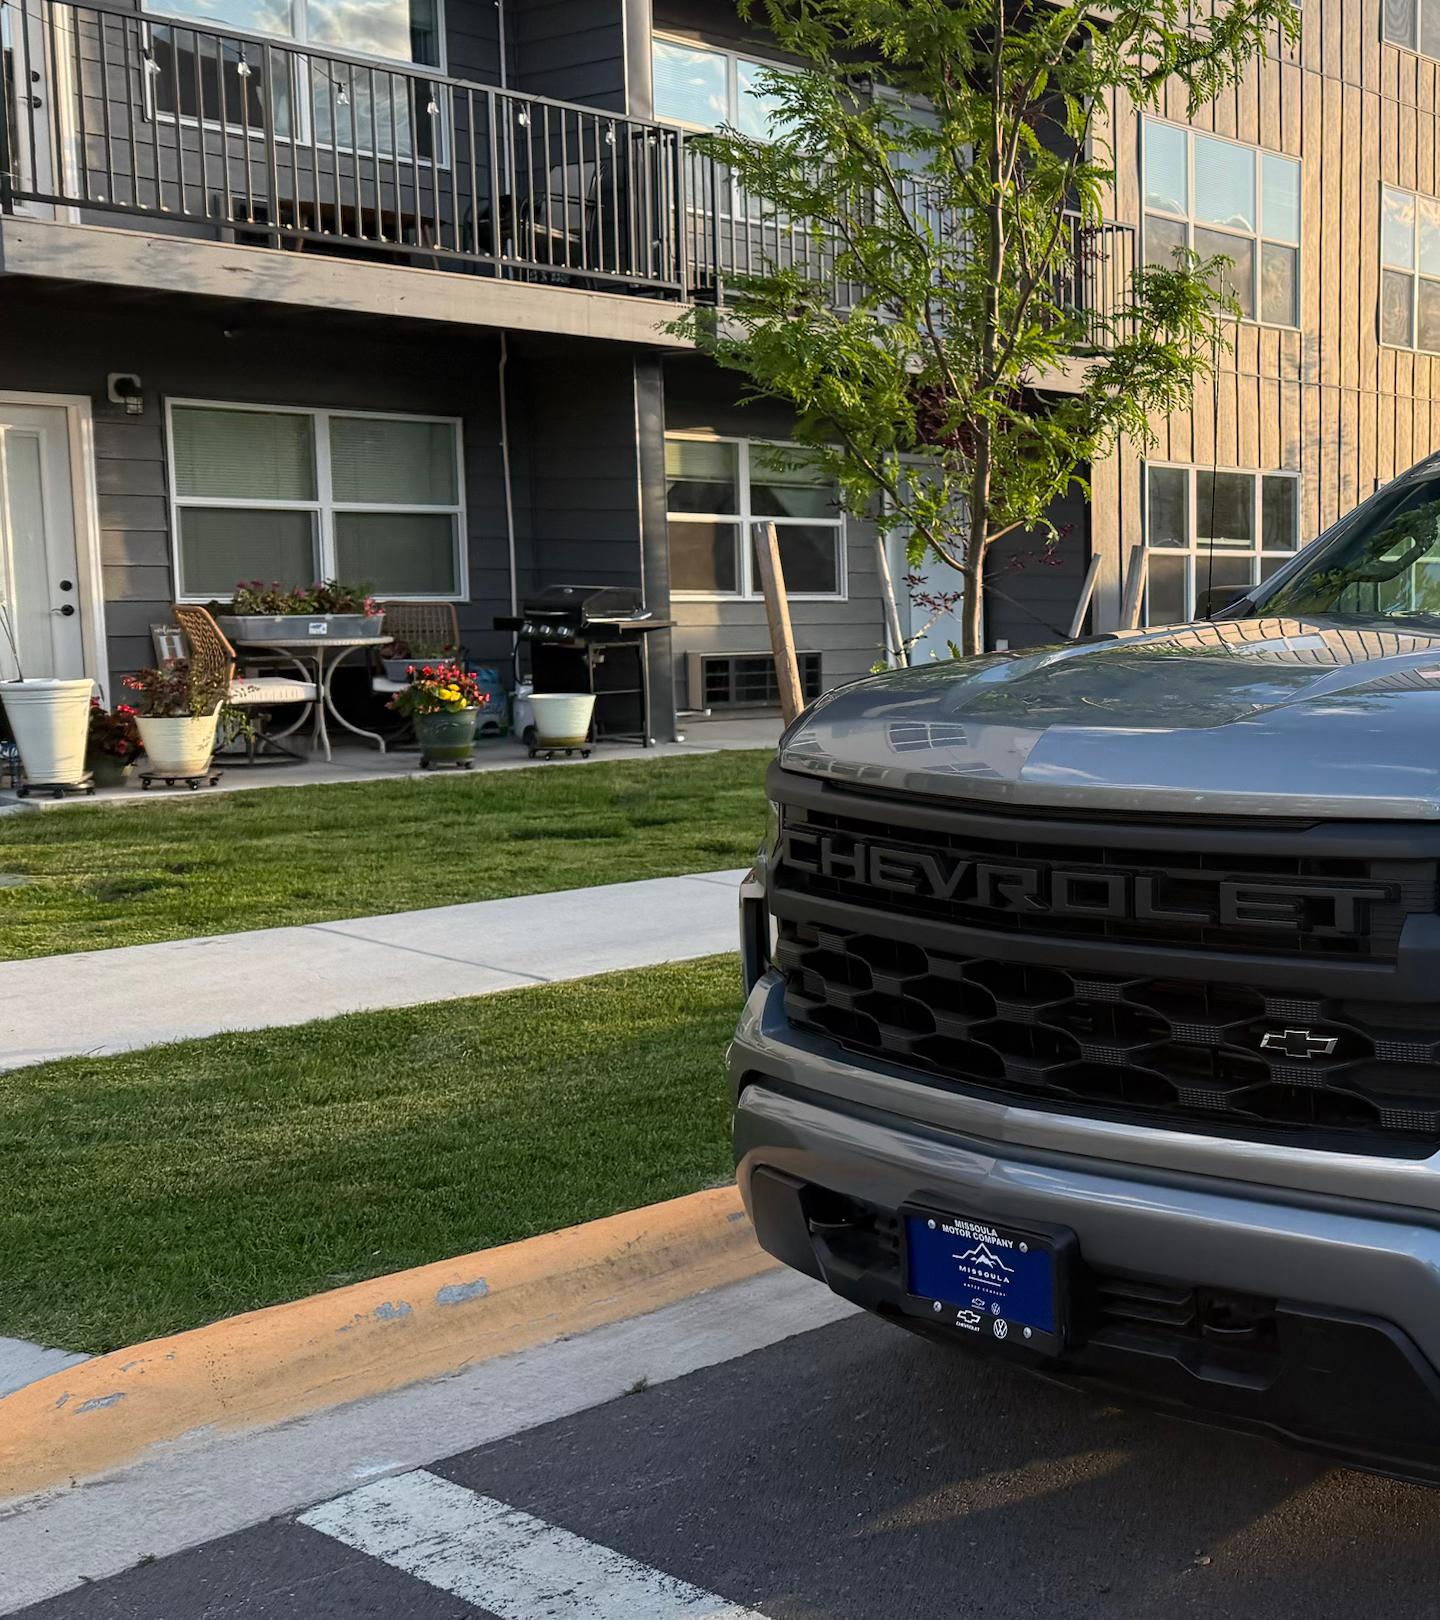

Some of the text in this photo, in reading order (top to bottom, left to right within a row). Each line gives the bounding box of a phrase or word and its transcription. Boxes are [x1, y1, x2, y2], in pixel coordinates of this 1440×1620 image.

[782, 829, 1397, 935] CHEVROLET
[942, 1224, 1014, 1248] MOTOR COMPANY
[954, 1219, 998, 1237] MISSOULA
[958, 1265, 1010, 1283] MISSOULA
